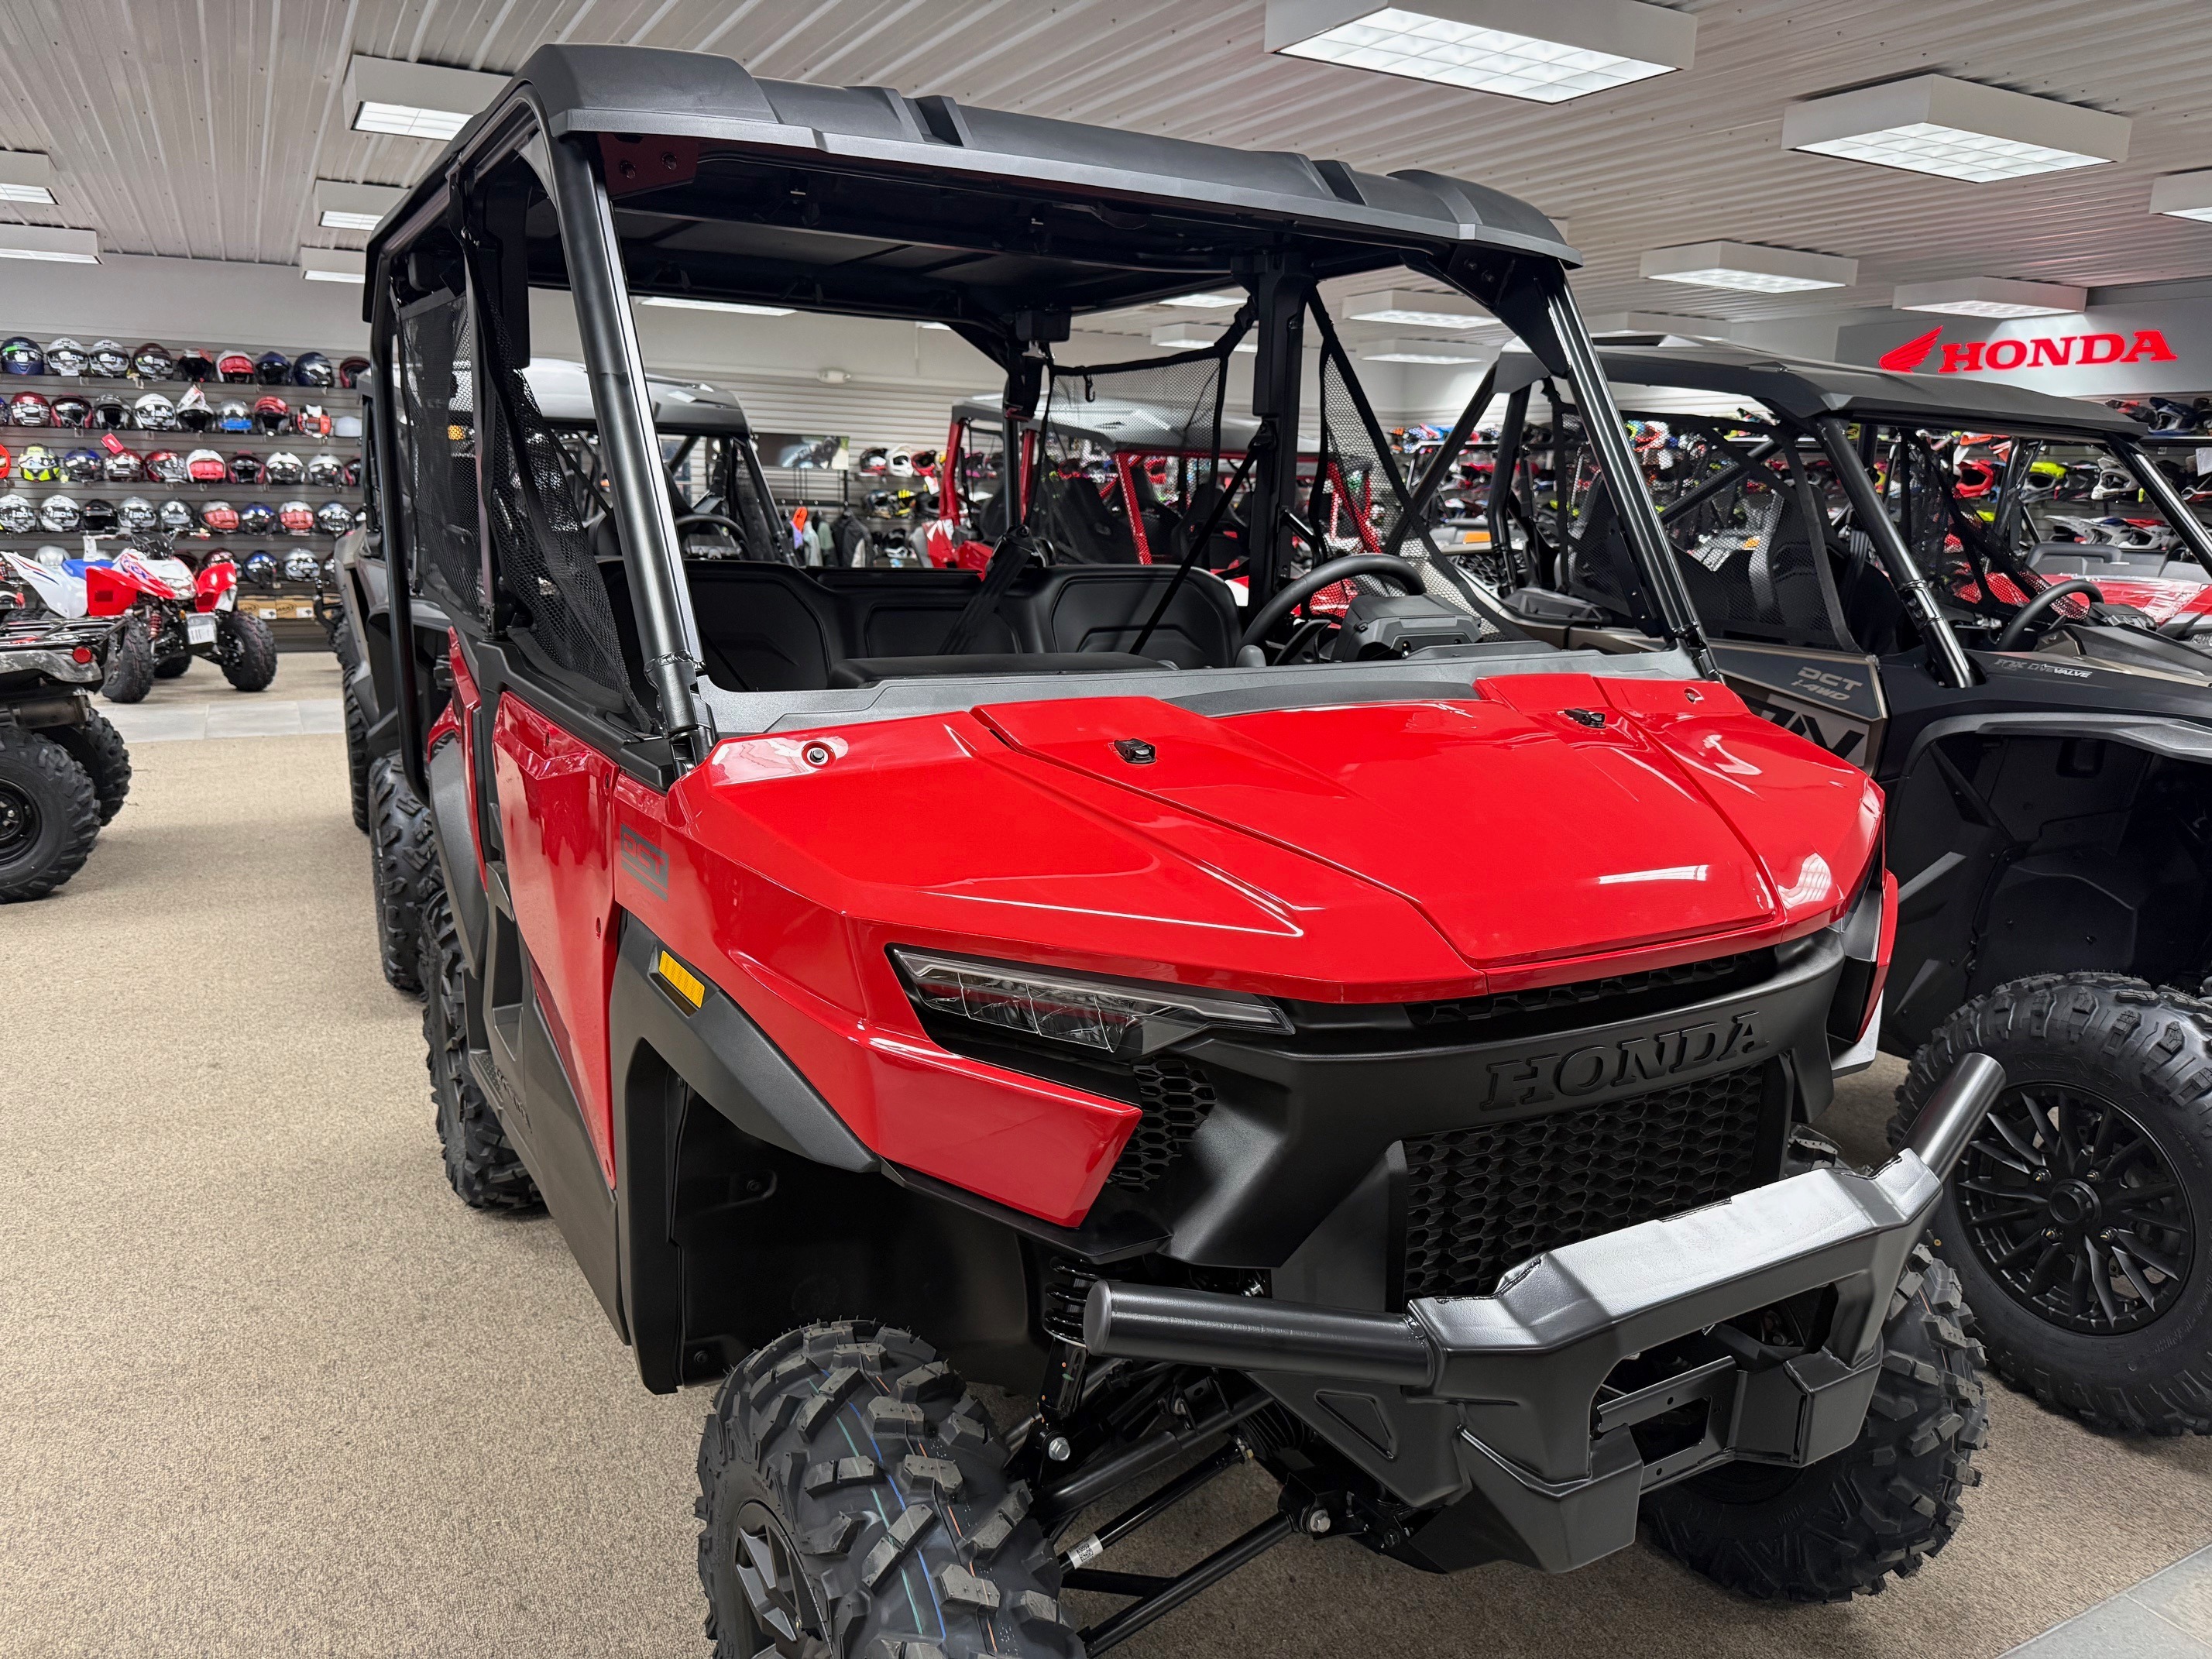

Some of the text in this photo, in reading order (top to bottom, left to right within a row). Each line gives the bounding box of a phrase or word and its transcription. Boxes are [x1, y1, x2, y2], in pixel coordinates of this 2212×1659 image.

[1938, 329, 2178, 373] HONDA
[1791, 679, 1850, 701] i-4WD
[1798, 666, 1863, 691] DCT
[623, 833, 665, 875] DCT
[1480, 1010, 1770, 1111] HONDA
